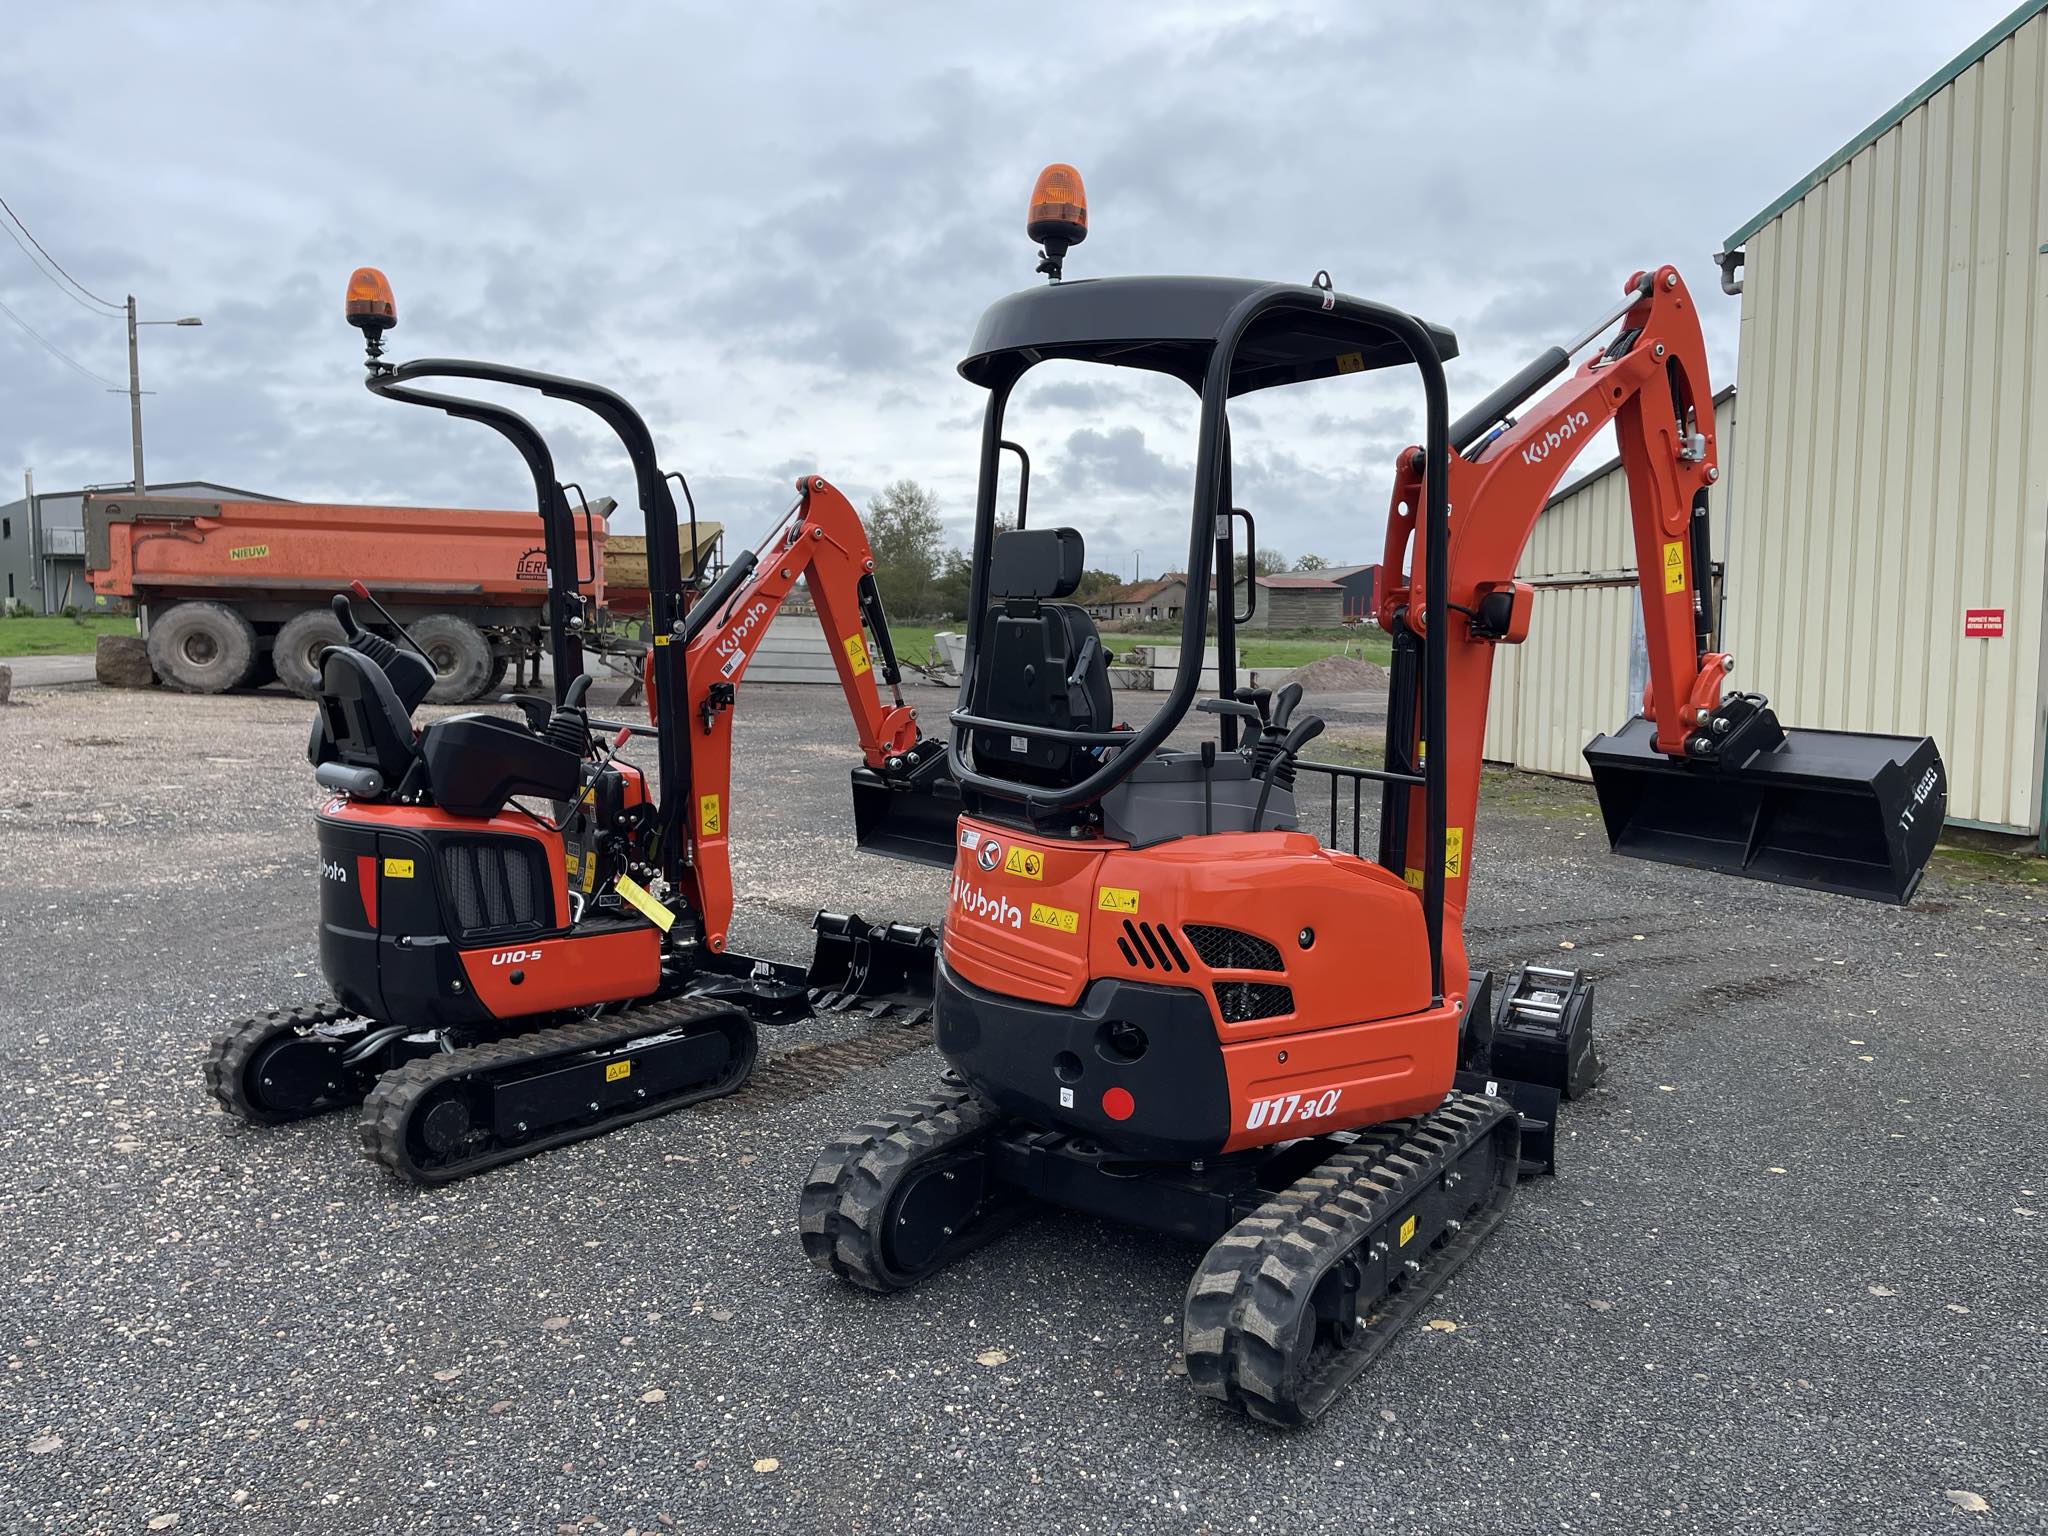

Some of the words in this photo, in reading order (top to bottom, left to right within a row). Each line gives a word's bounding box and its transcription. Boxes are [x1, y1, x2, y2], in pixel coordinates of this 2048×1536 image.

[1522, 411, 1589, 465] Kubota
[231, 545, 267, 559] NIEUW
[715, 602, 768, 658] Kubota
[960, 880, 1022, 929] Kubota
[491, 950, 542, 966] U10-5
